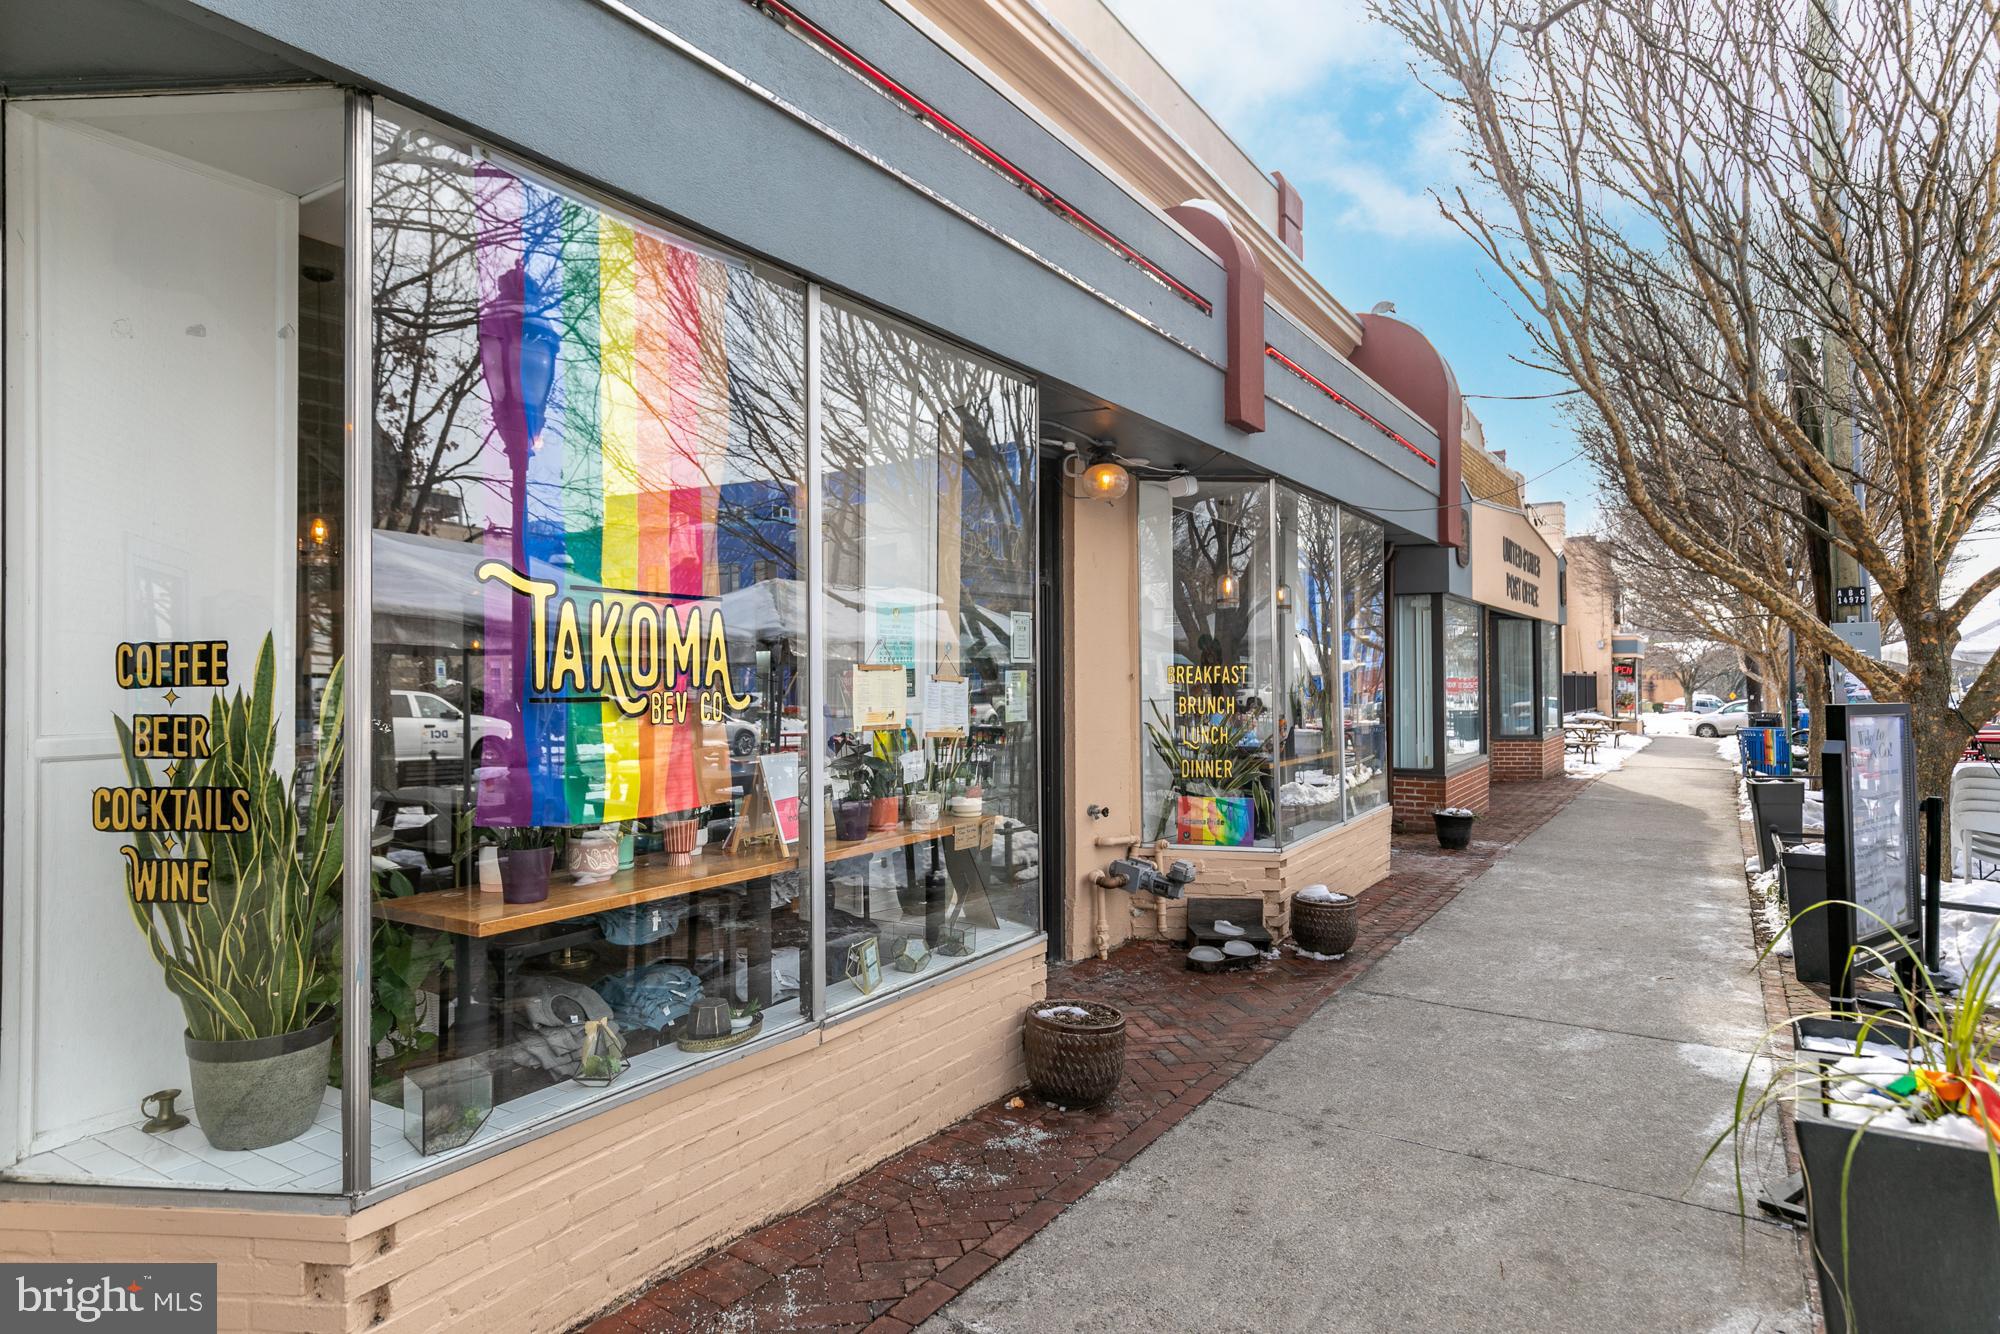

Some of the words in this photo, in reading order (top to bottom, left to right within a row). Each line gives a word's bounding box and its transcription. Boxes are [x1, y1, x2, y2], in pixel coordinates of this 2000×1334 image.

[1502, 535, 1522, 569] UNITED
[1522, 547, 1541, 578] STATES
[1506, 572, 1522, 601] POST
[1521, 579, 1539, 608] OFFICE
[1838, 596, 1866, 604] 14979
[474, 559, 751, 718] TAKOMA
[116, 641, 229, 688] COFFEE
[1167, 665, 1248, 684] BREAKFAST
[650, 691, 688, 724] BEV
[699, 691, 723, 721] CO
[1179, 696, 1235, 715] BRUNCH
[133, 714, 211, 759] BEER
[1182, 726, 1229, 750] LUNCH
[1181, 760, 1233, 778] DINNER
[93, 787, 250, 832] COCKTAILS
[120, 845, 210, 904] WINE
